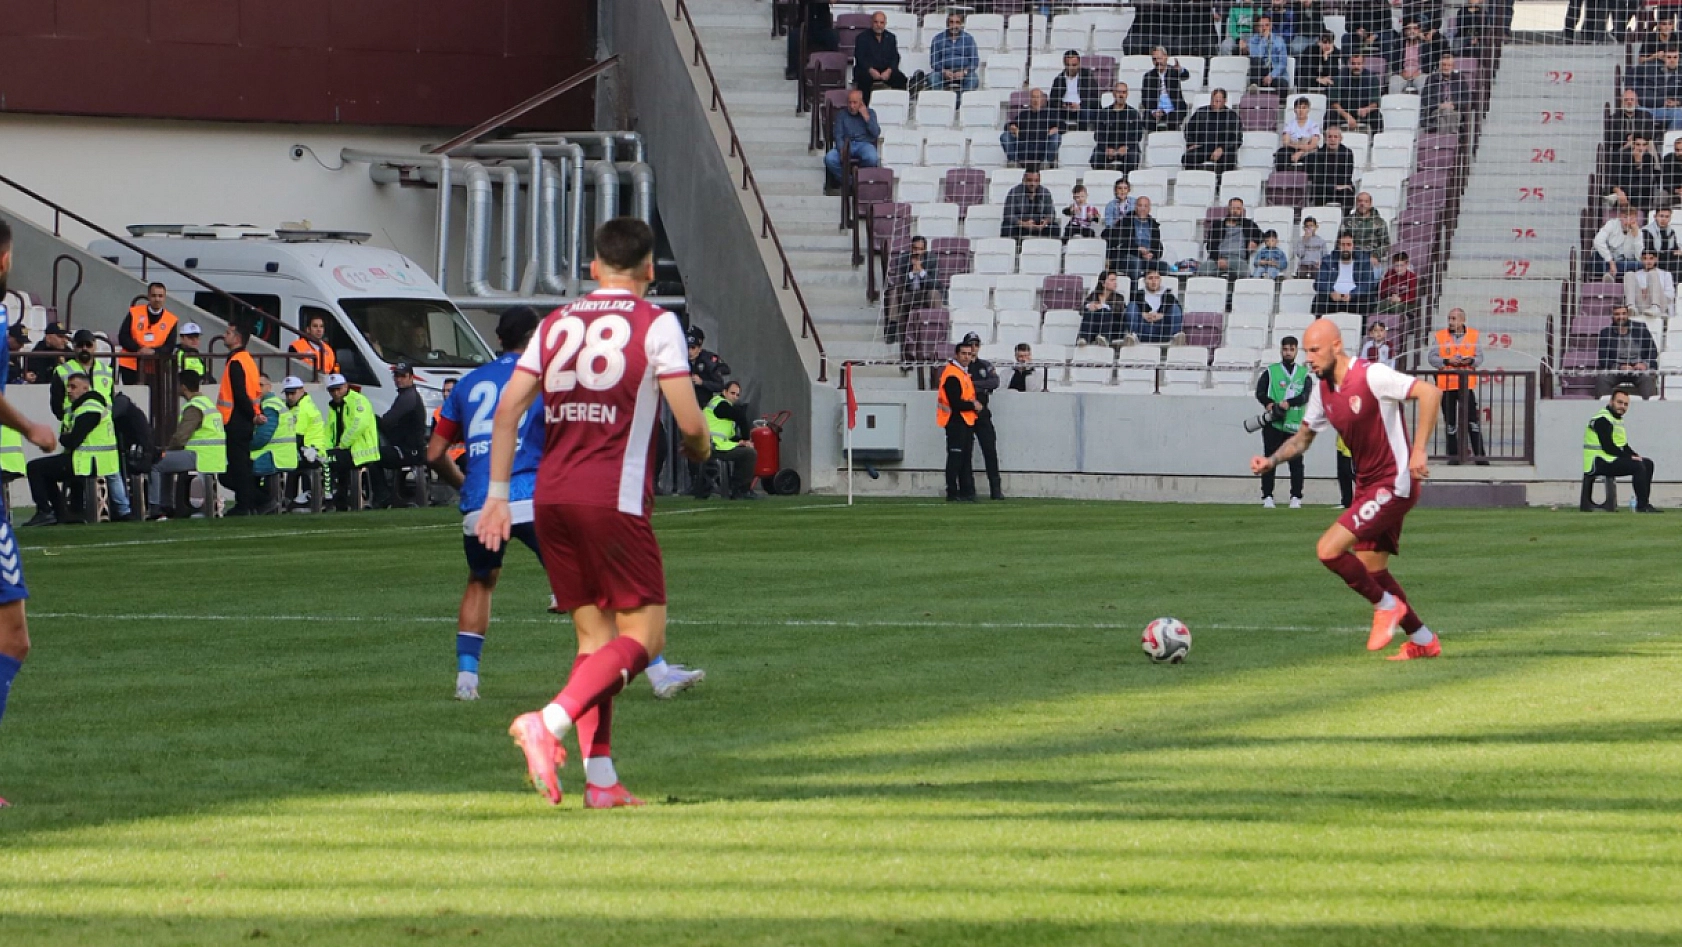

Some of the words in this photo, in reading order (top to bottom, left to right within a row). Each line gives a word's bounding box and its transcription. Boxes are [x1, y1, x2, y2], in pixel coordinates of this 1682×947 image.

[1530, 148, 1556, 162] 24
[1503, 260, 1530, 276] 27
[1490, 297, 1518, 314] 28
[544, 314, 632, 393] 28
[1358, 499, 1381, 520] 6
